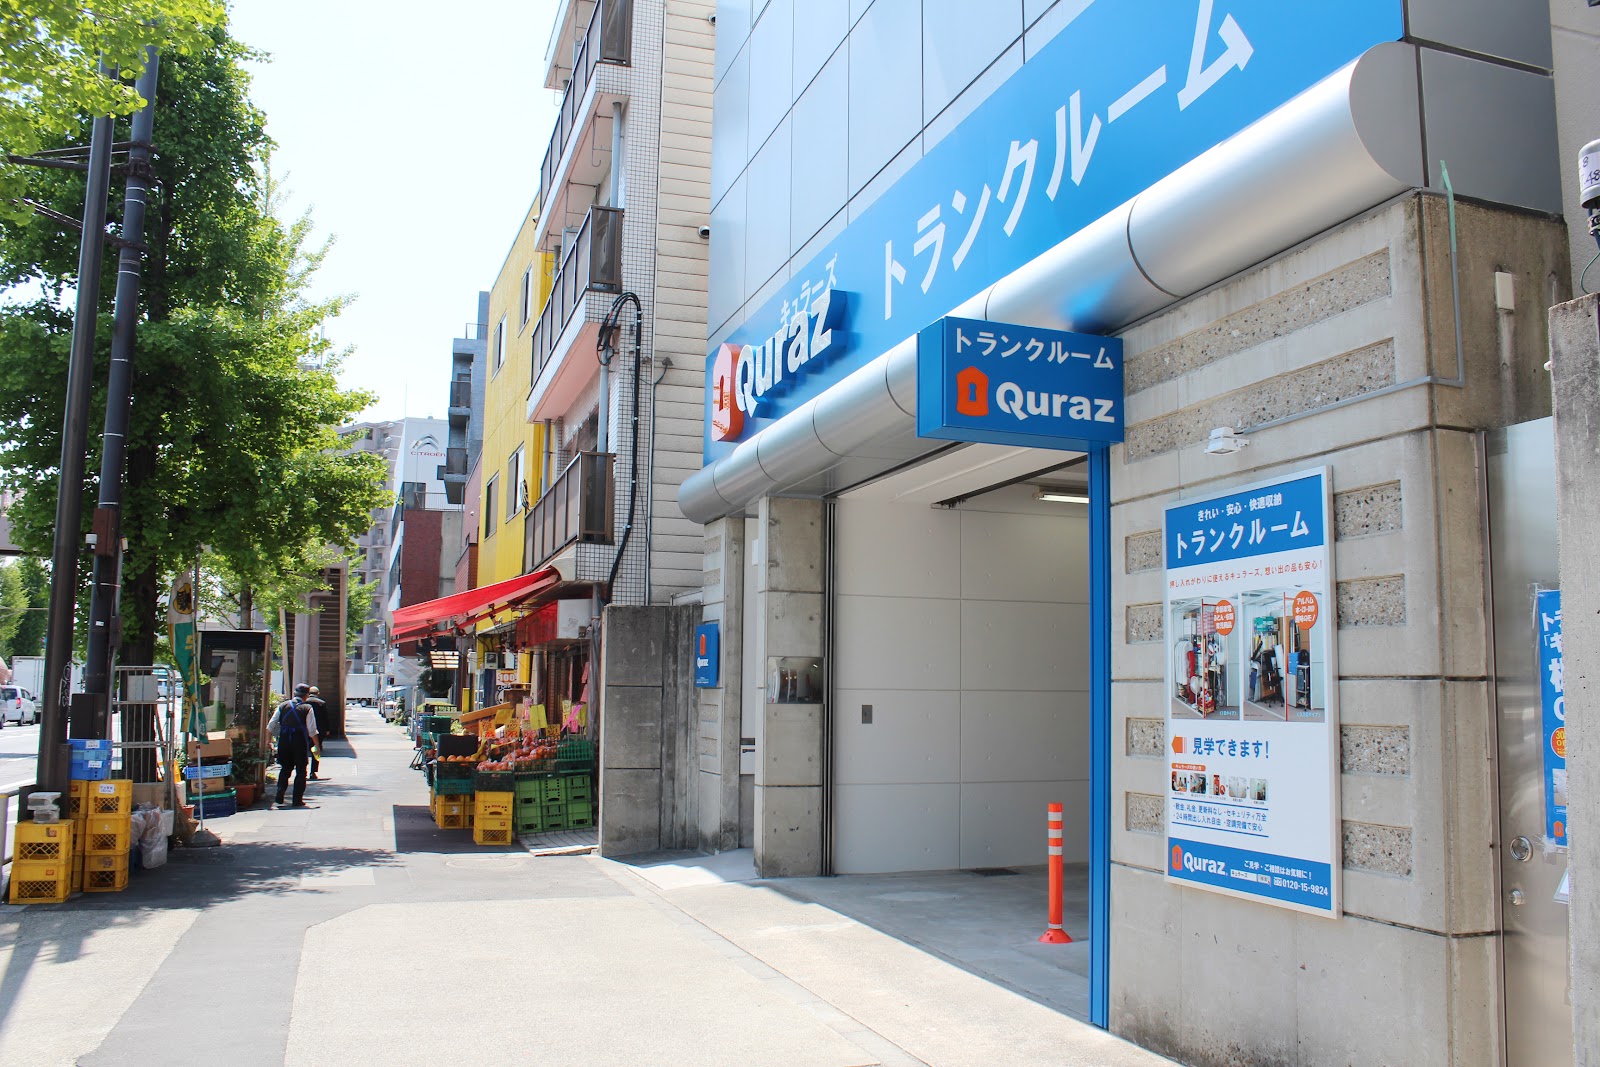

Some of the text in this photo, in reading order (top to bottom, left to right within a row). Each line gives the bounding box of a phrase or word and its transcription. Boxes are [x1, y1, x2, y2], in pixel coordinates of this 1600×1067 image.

[885, 0, 1254, 320] トランクルーム
[780, 252, 838, 326] キュラーズ
[735, 288, 832, 418] Quraz
[956, 327, 1114, 370] トランクルーム
[996, 381, 1115, 423] Quraz
[1197, 492, 1283, 522] きれい・安心・快適収納
[1177, 510, 1310, 559] トランクルーム
[1192, 737, 1269, 759] 見学できます！
[1183, 851, 1226, 876] Quraz
[1282, 879, 1329, 896] 0120-15-9824
